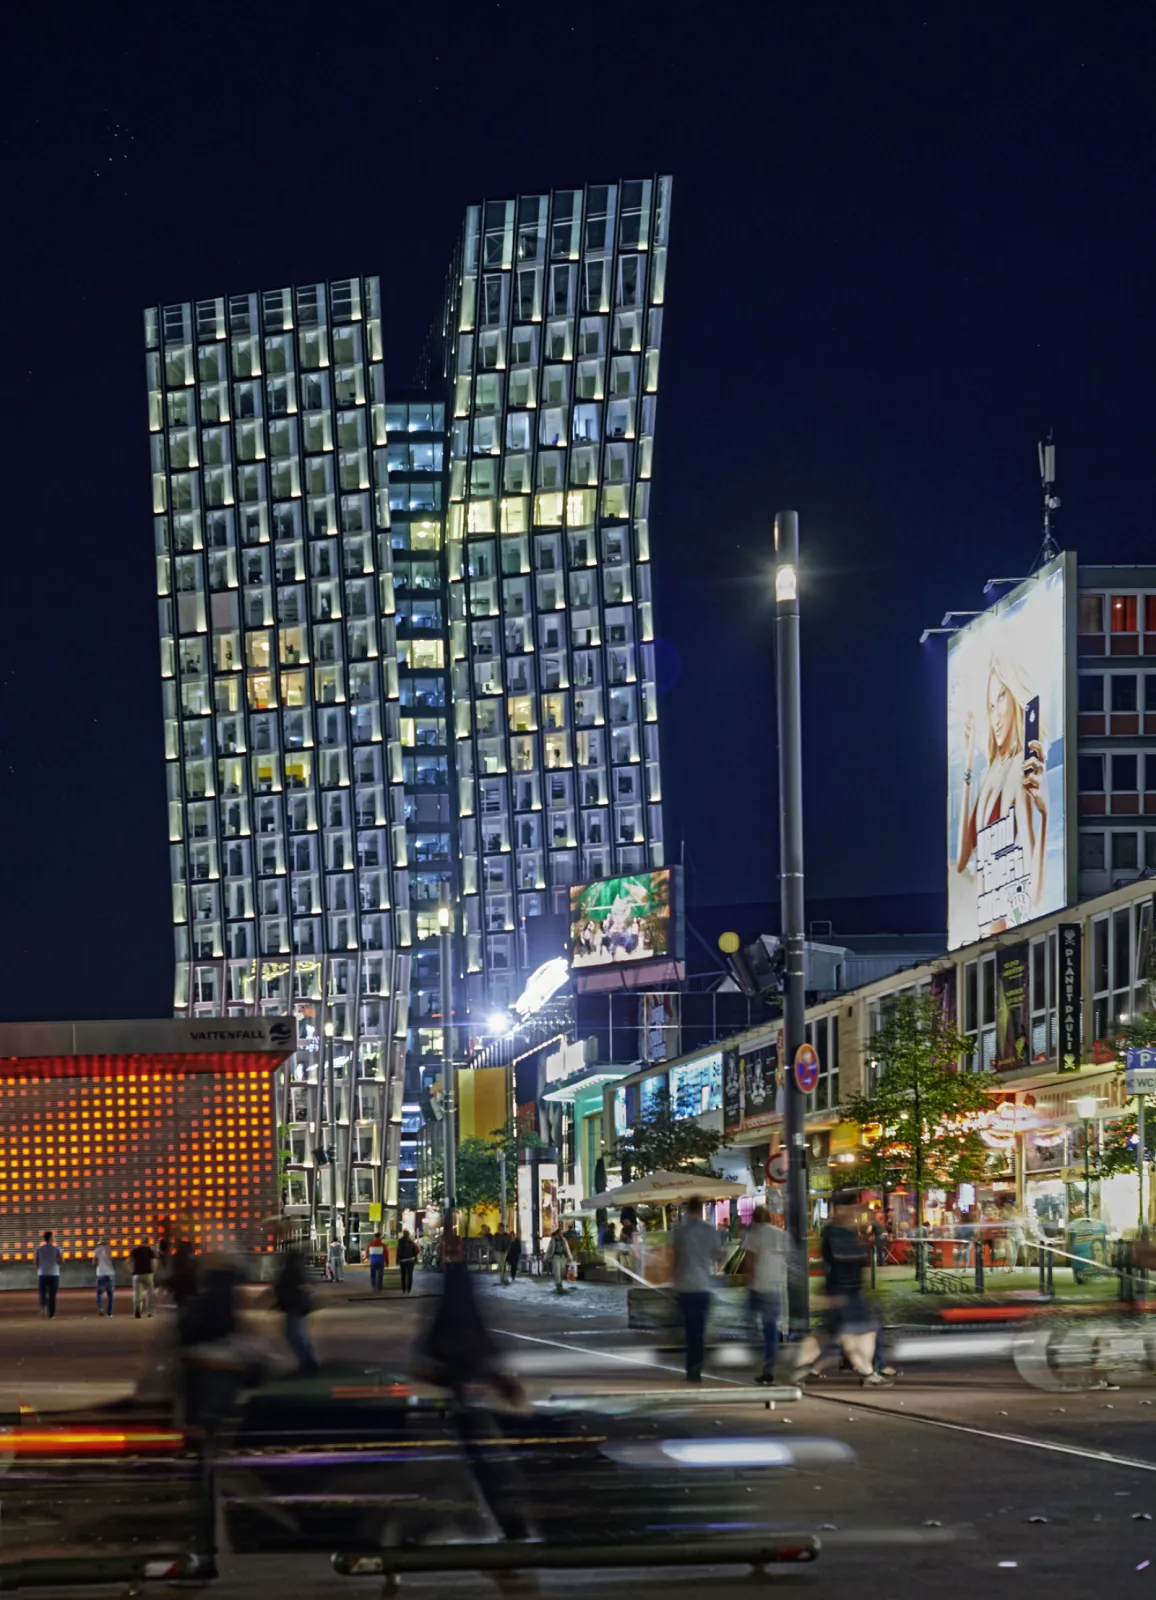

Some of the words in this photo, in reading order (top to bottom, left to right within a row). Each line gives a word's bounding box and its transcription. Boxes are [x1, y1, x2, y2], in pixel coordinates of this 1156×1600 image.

[1064, 948, 1075, 1002] PLANET
[1064, 1005, 1075, 1050] PAULI
[190, 1030, 265, 1041] VATTENFALL
[1140, 1053, 1151, 1067] P
[1136, 1078, 1154, 1088] WC
